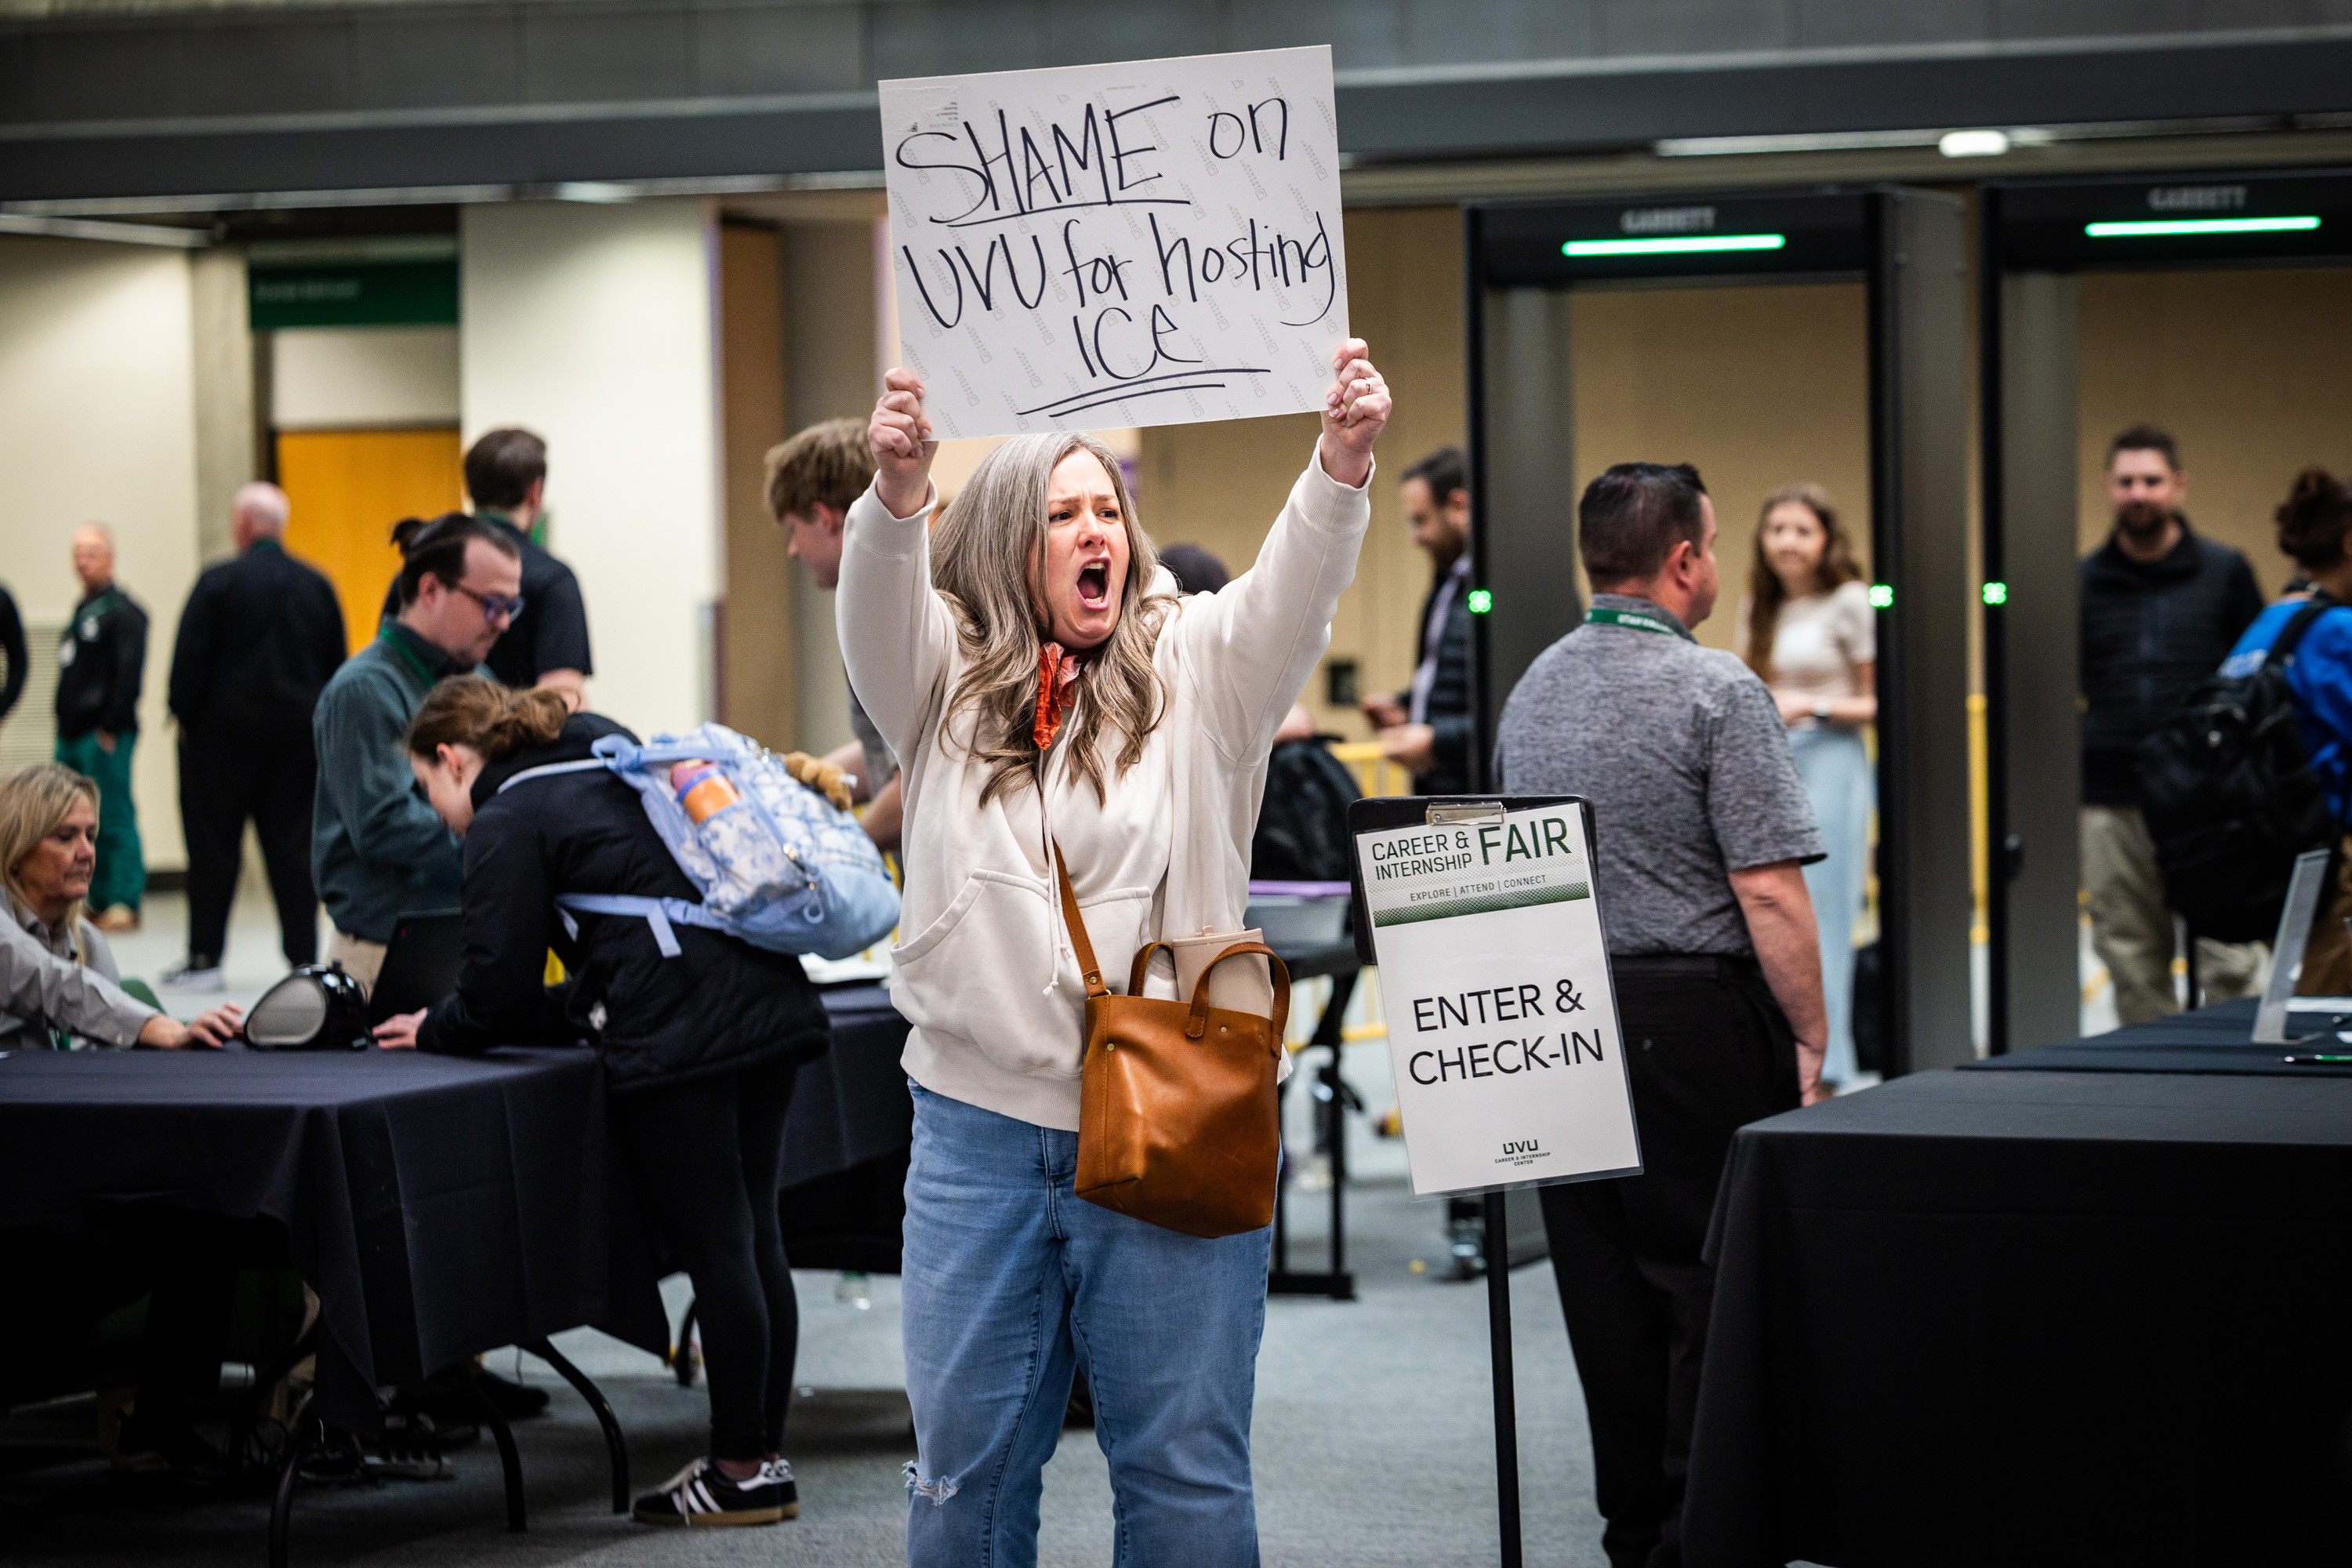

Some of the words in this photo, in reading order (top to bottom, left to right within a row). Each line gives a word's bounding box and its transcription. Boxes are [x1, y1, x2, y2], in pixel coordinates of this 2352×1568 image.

[896, 96, 1180, 223] SHAME
[1207, 97, 1288, 161] on
[902, 233, 1046, 328] UVU
[1063, 219, 1134, 309] for
[1149, 210, 1335, 326] hosting
[1372, 832, 1448, 862] CAREER
[1456, 830, 1470, 849] &
[1376, 852, 1472, 880] INTERNSHIP
[1479, 817, 1572, 866] FAIR
[1410, 887, 1451, 902] EXPLORE
[1460, 880, 1495, 895] ATTEND
[1504, 874, 1547, 888] CONNECT
[1413, 983, 1544, 1033] ENTER
[1555, 978, 1586, 1014] &
[1410, 1029, 1605, 1086] CHECK-IN
[1503, 1139, 1538, 1155] UVU
